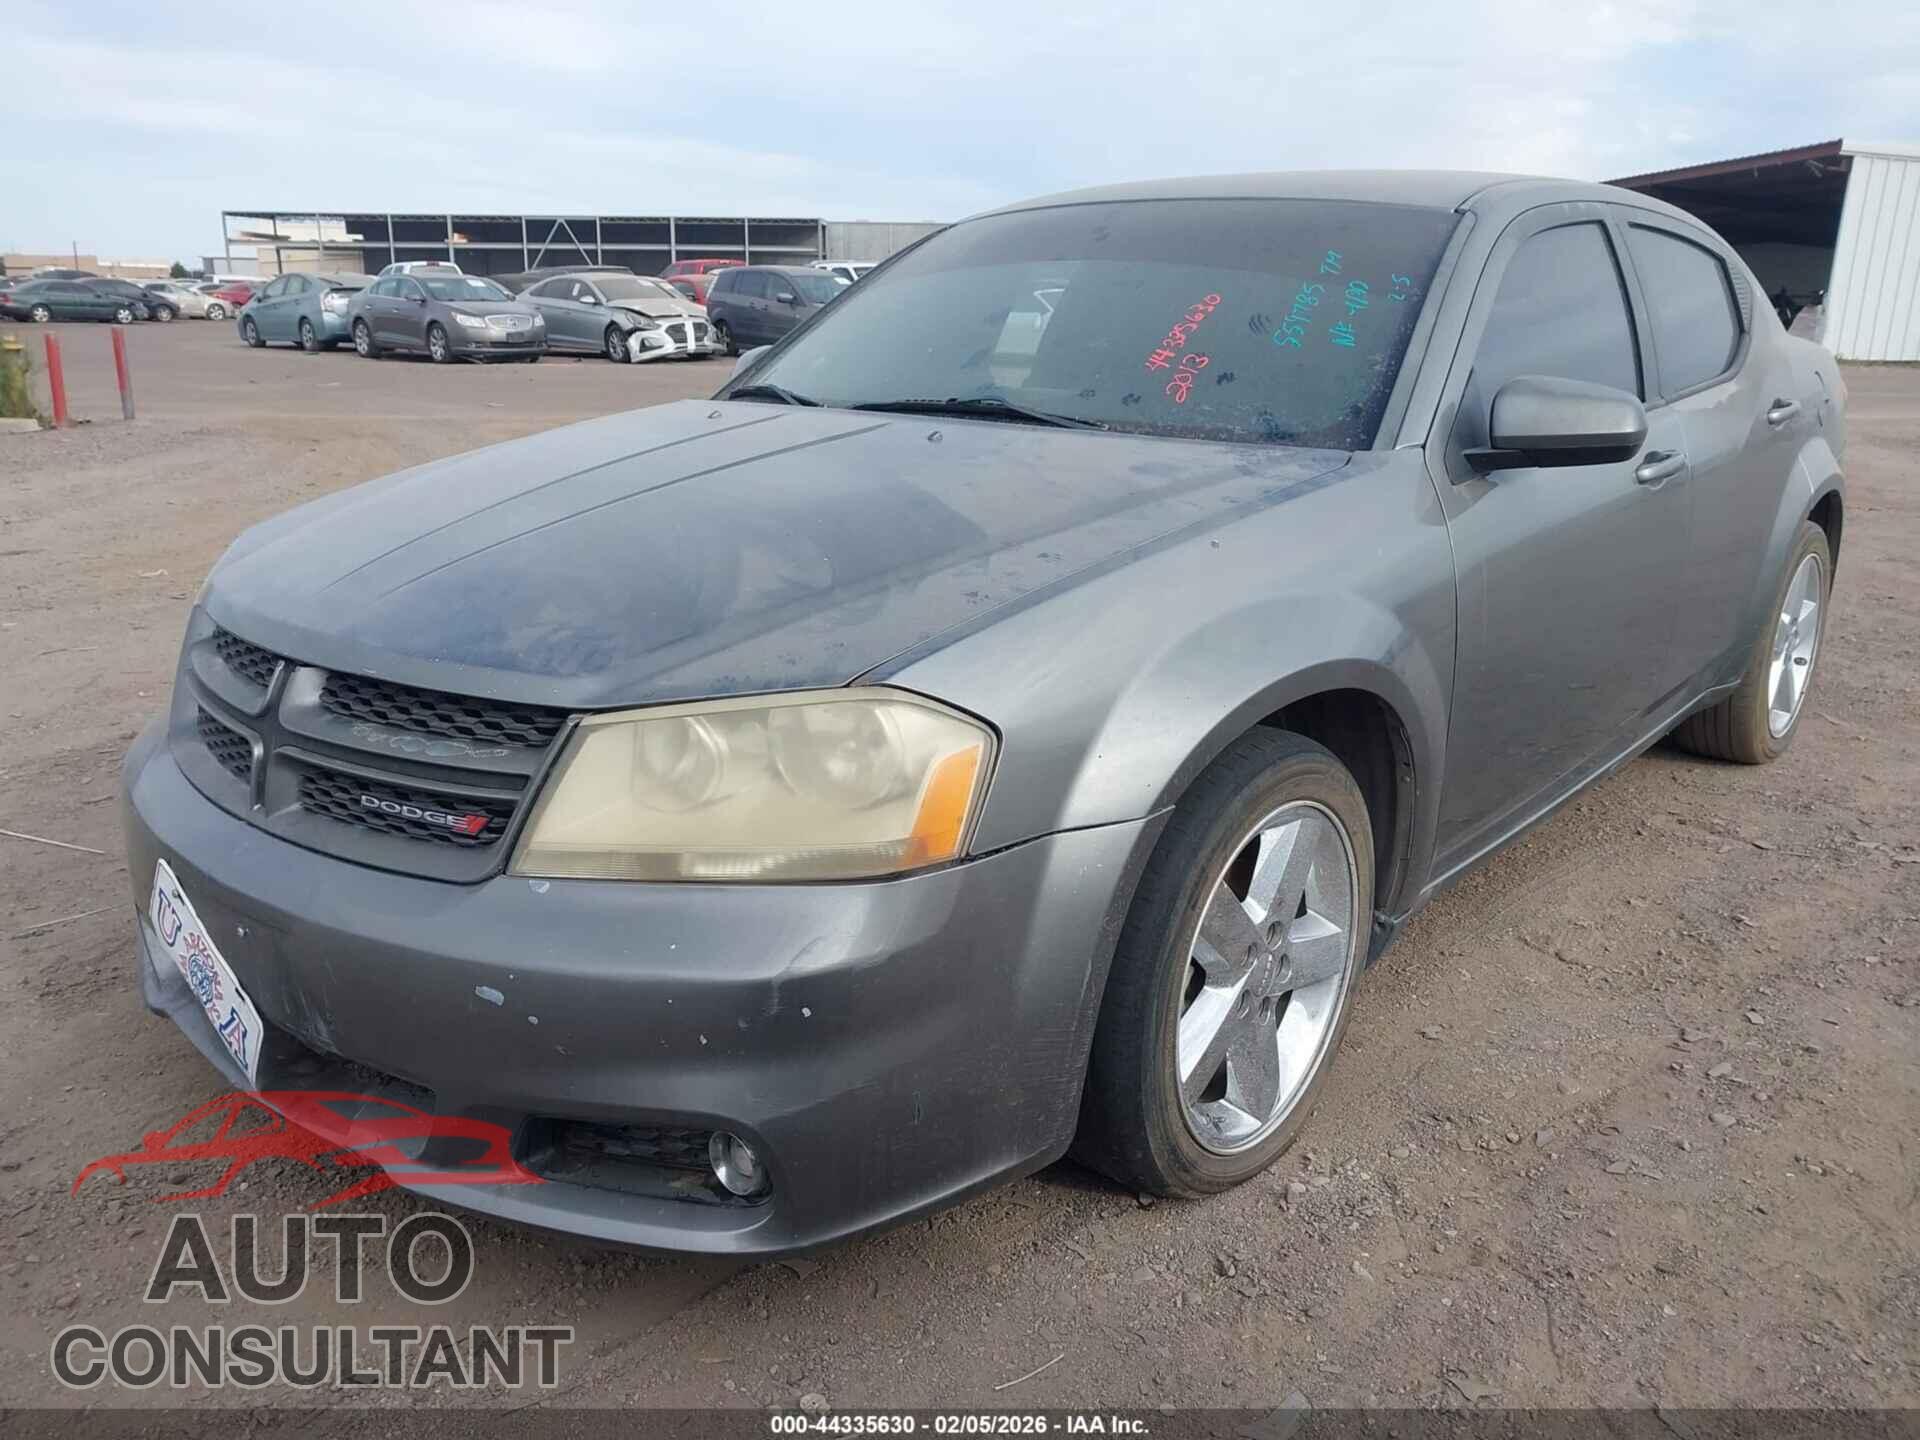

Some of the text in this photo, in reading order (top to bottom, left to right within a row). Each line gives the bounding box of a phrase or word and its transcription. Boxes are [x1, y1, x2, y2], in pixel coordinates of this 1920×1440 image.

[1165, 353, 1210, 404] 2013
[360, 794, 471, 832] DODGE
[158, 887, 183, 948] U
